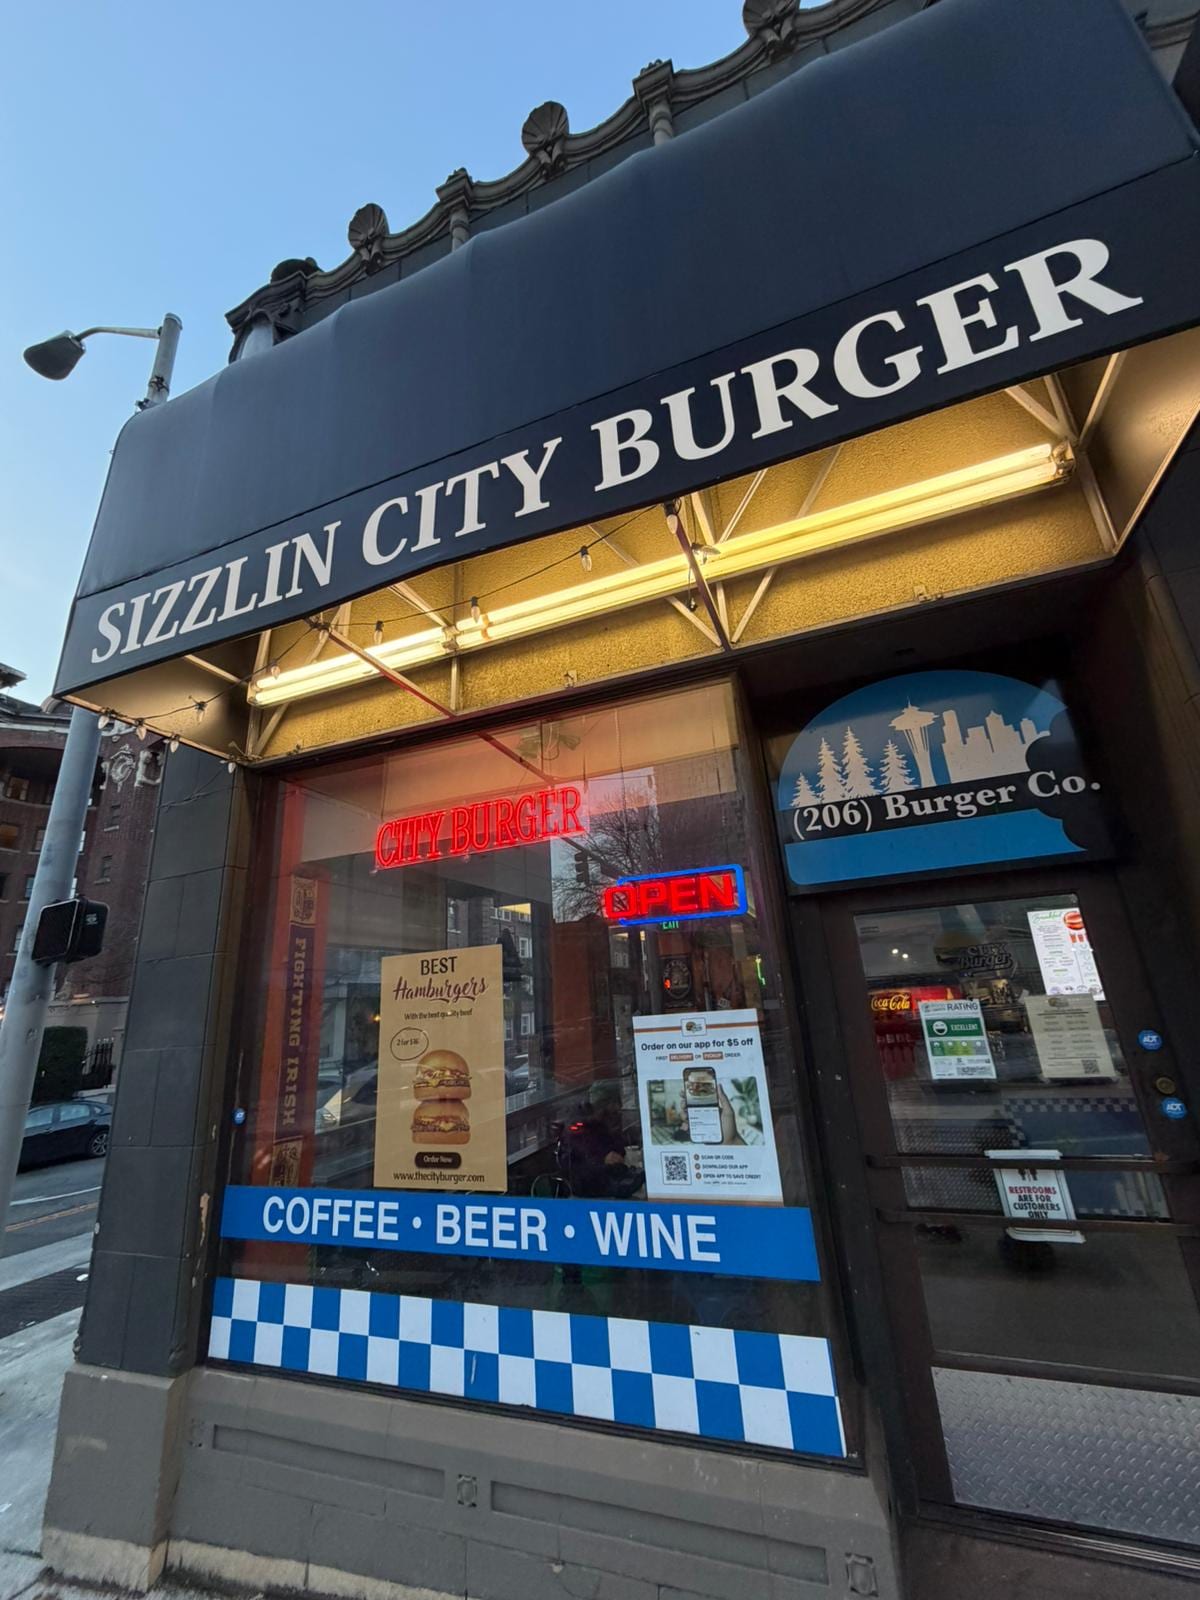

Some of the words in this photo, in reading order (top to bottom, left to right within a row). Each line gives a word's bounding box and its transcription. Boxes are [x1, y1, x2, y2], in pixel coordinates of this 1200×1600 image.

[91, 520, 341, 664] SIZZLIN
[362, 437, 562, 566] CITY
[591, 238, 1143, 491] BURGER
[793, 800, 872, 840] (206)
[884, 784, 1016, 818] Burger
[1027, 770, 1101, 798] Co.
[376, 810, 446, 867] CITY
[451, 786, 585, 853] BURGER
[603, 873, 735, 919] OPEN
[420, 956, 458, 976] BEST
[288, 938, 306, 1047] FIGHTING
[393, 976, 488, 1003] Hamburgers
[947, 1003, 979, 1011] RATING
[641, 1043, 664, 1051] Order
[694, 1041, 710, 1049] app
[727, 1038, 739, 1047] $5
[741, 1038, 753, 1046] off
[282, 1057, 299, 1126] IRISH
[393, 1171, 485, 1184] www.thecityburger.com
[1008, 1186, 1057, 1194] RESTROOMS
[1013, 1203, 1061, 1211] CUSTOMERS
[263, 1196, 399, 1241] COFFEE
[436, 1204, 548, 1252] BEER
[589, 1211, 721, 1263] WINE
